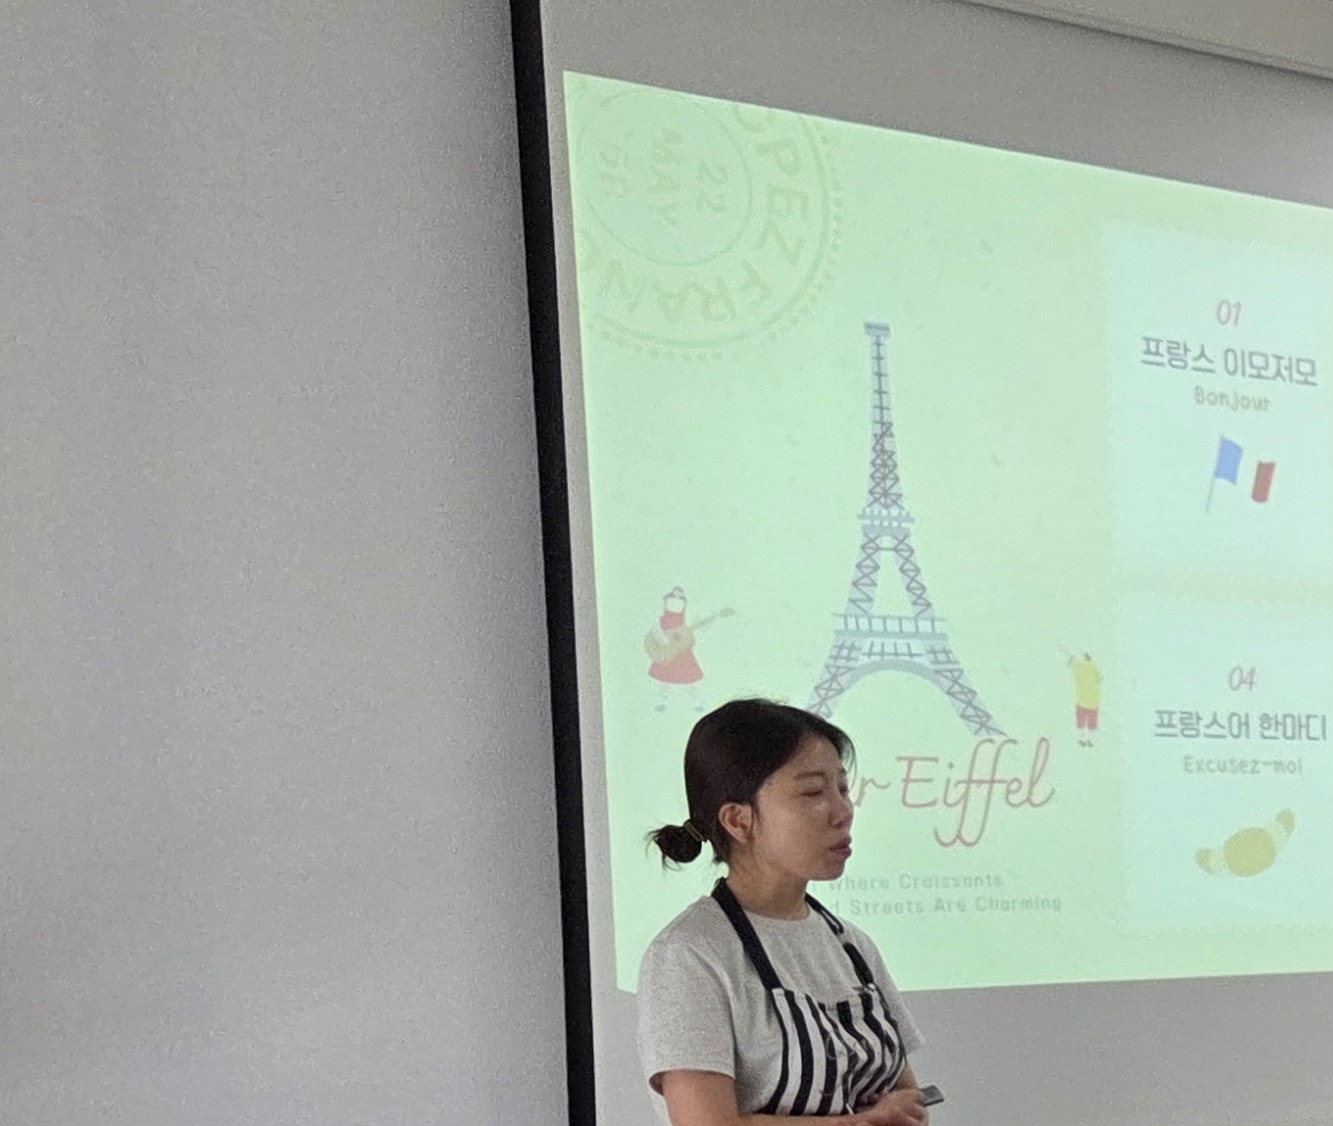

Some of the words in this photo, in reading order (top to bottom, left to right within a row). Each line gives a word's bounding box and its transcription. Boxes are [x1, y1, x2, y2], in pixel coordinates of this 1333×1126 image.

[1216, 299, 1242, 327] 01
[1141, 336, 1216, 374] 프랑스
[1223, 347, 1318, 387] 이모저모
[1194, 385, 1271, 412] Bonjour
[1228, 666, 1257, 692] 04
[1154, 710, 1250, 739] 프랑스어
[1259, 712, 1328, 741] 한마디
[1183, 755, 1304, 775] Excusez-moi
[896, 737, 1056, 847] Eiffel
[899, 873, 1004, 891] Croissants
[850, 898, 925, 917] Streets
[934, 896, 968, 914] Are
[975, 895, 1063, 914] Charming
